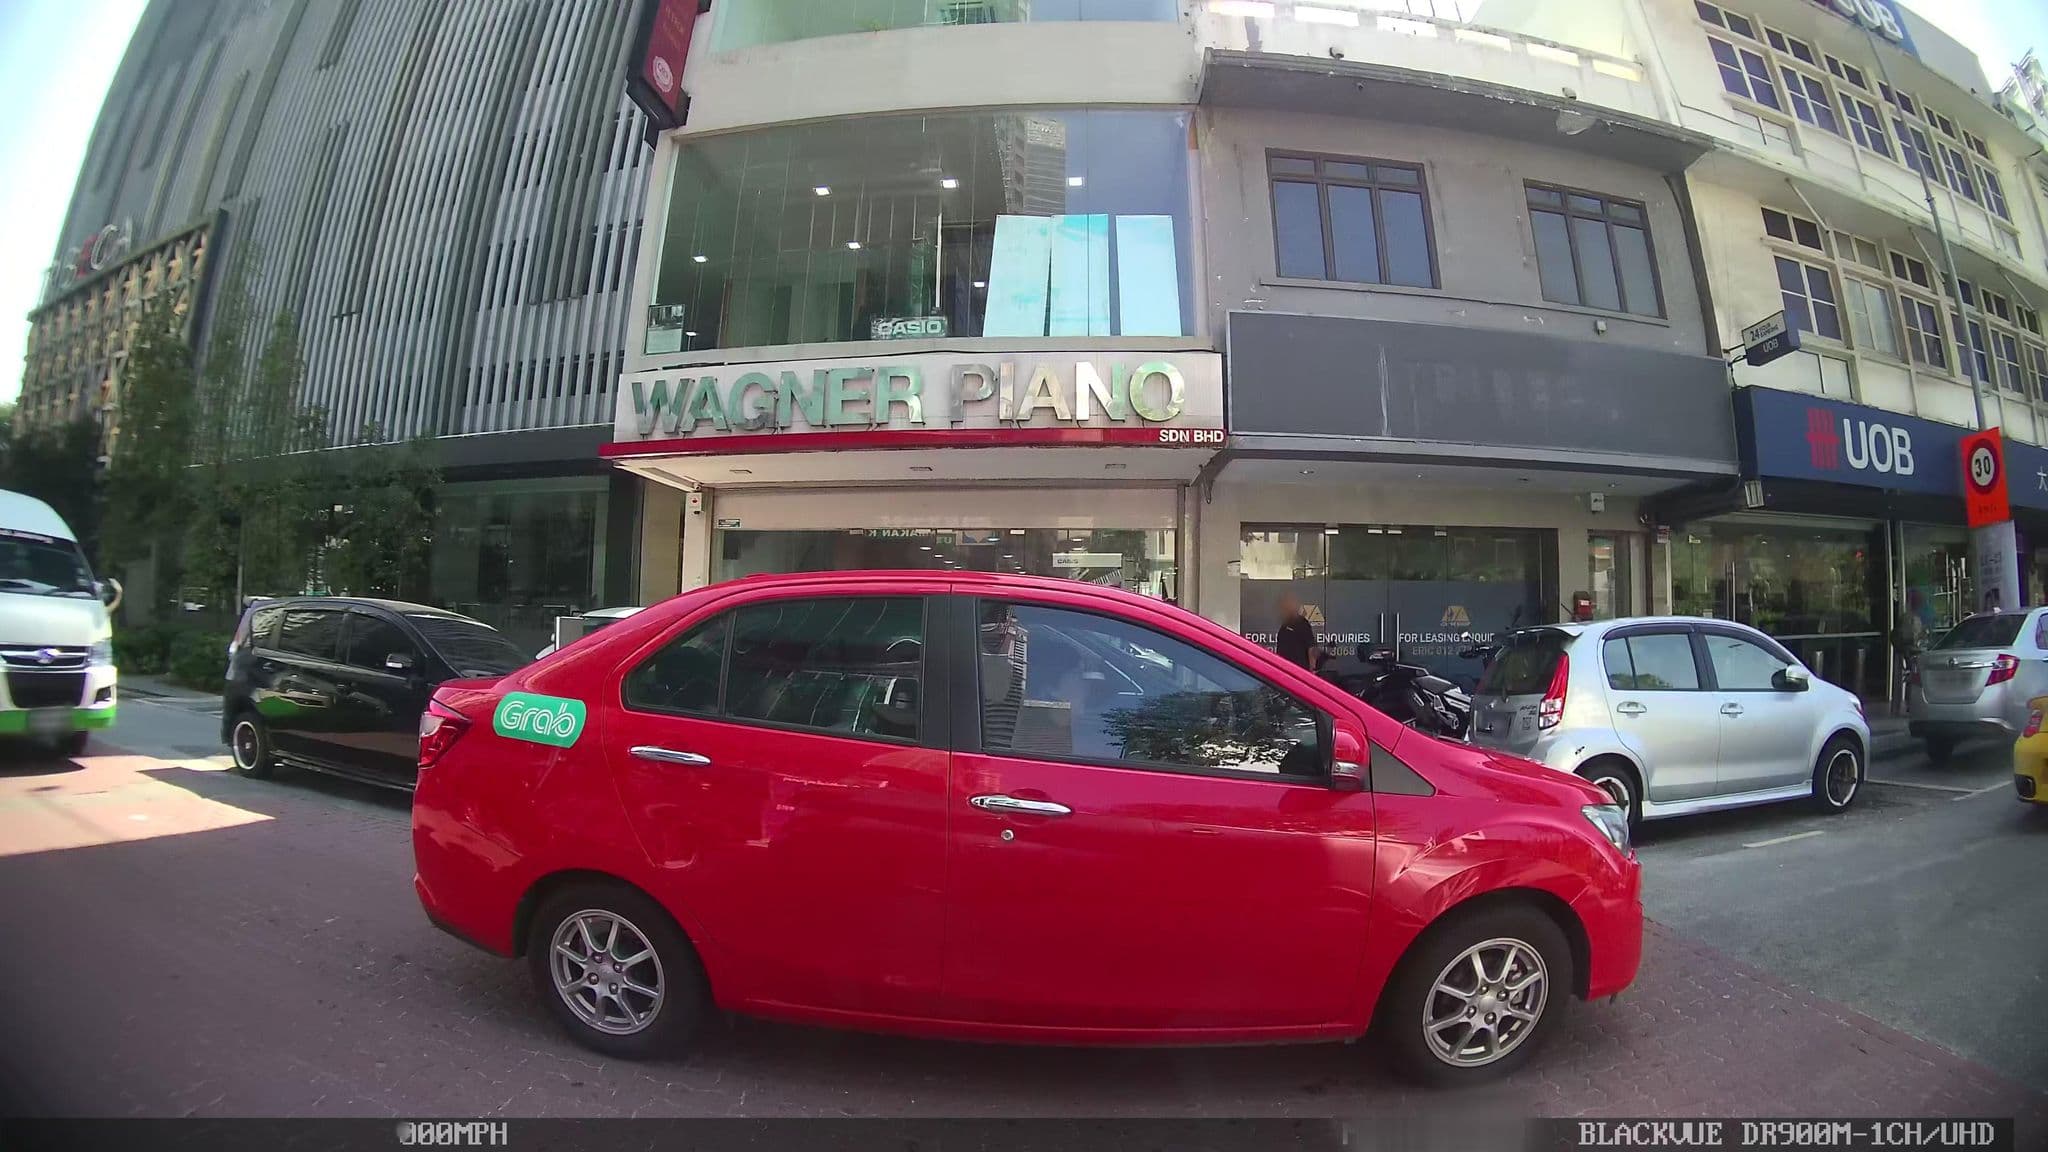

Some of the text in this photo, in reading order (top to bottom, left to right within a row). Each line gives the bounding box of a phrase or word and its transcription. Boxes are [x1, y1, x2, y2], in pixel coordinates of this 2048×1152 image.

[1763, 338, 1779, 353] UOB
[631, 360, 1185, 435] WAGNER PIANO
[1159, 429, 1224, 443] SDN BHD
[1843, 418, 1915, 475] UOB
[1974, 455, 1991, 478] 30
[1316, 633, 1370, 643] ENQUIRIES
[1399, 633, 1418, 643] FOR
[1420, 633, 1460, 643] LEASING
[501, 700, 576, 737] Grab
